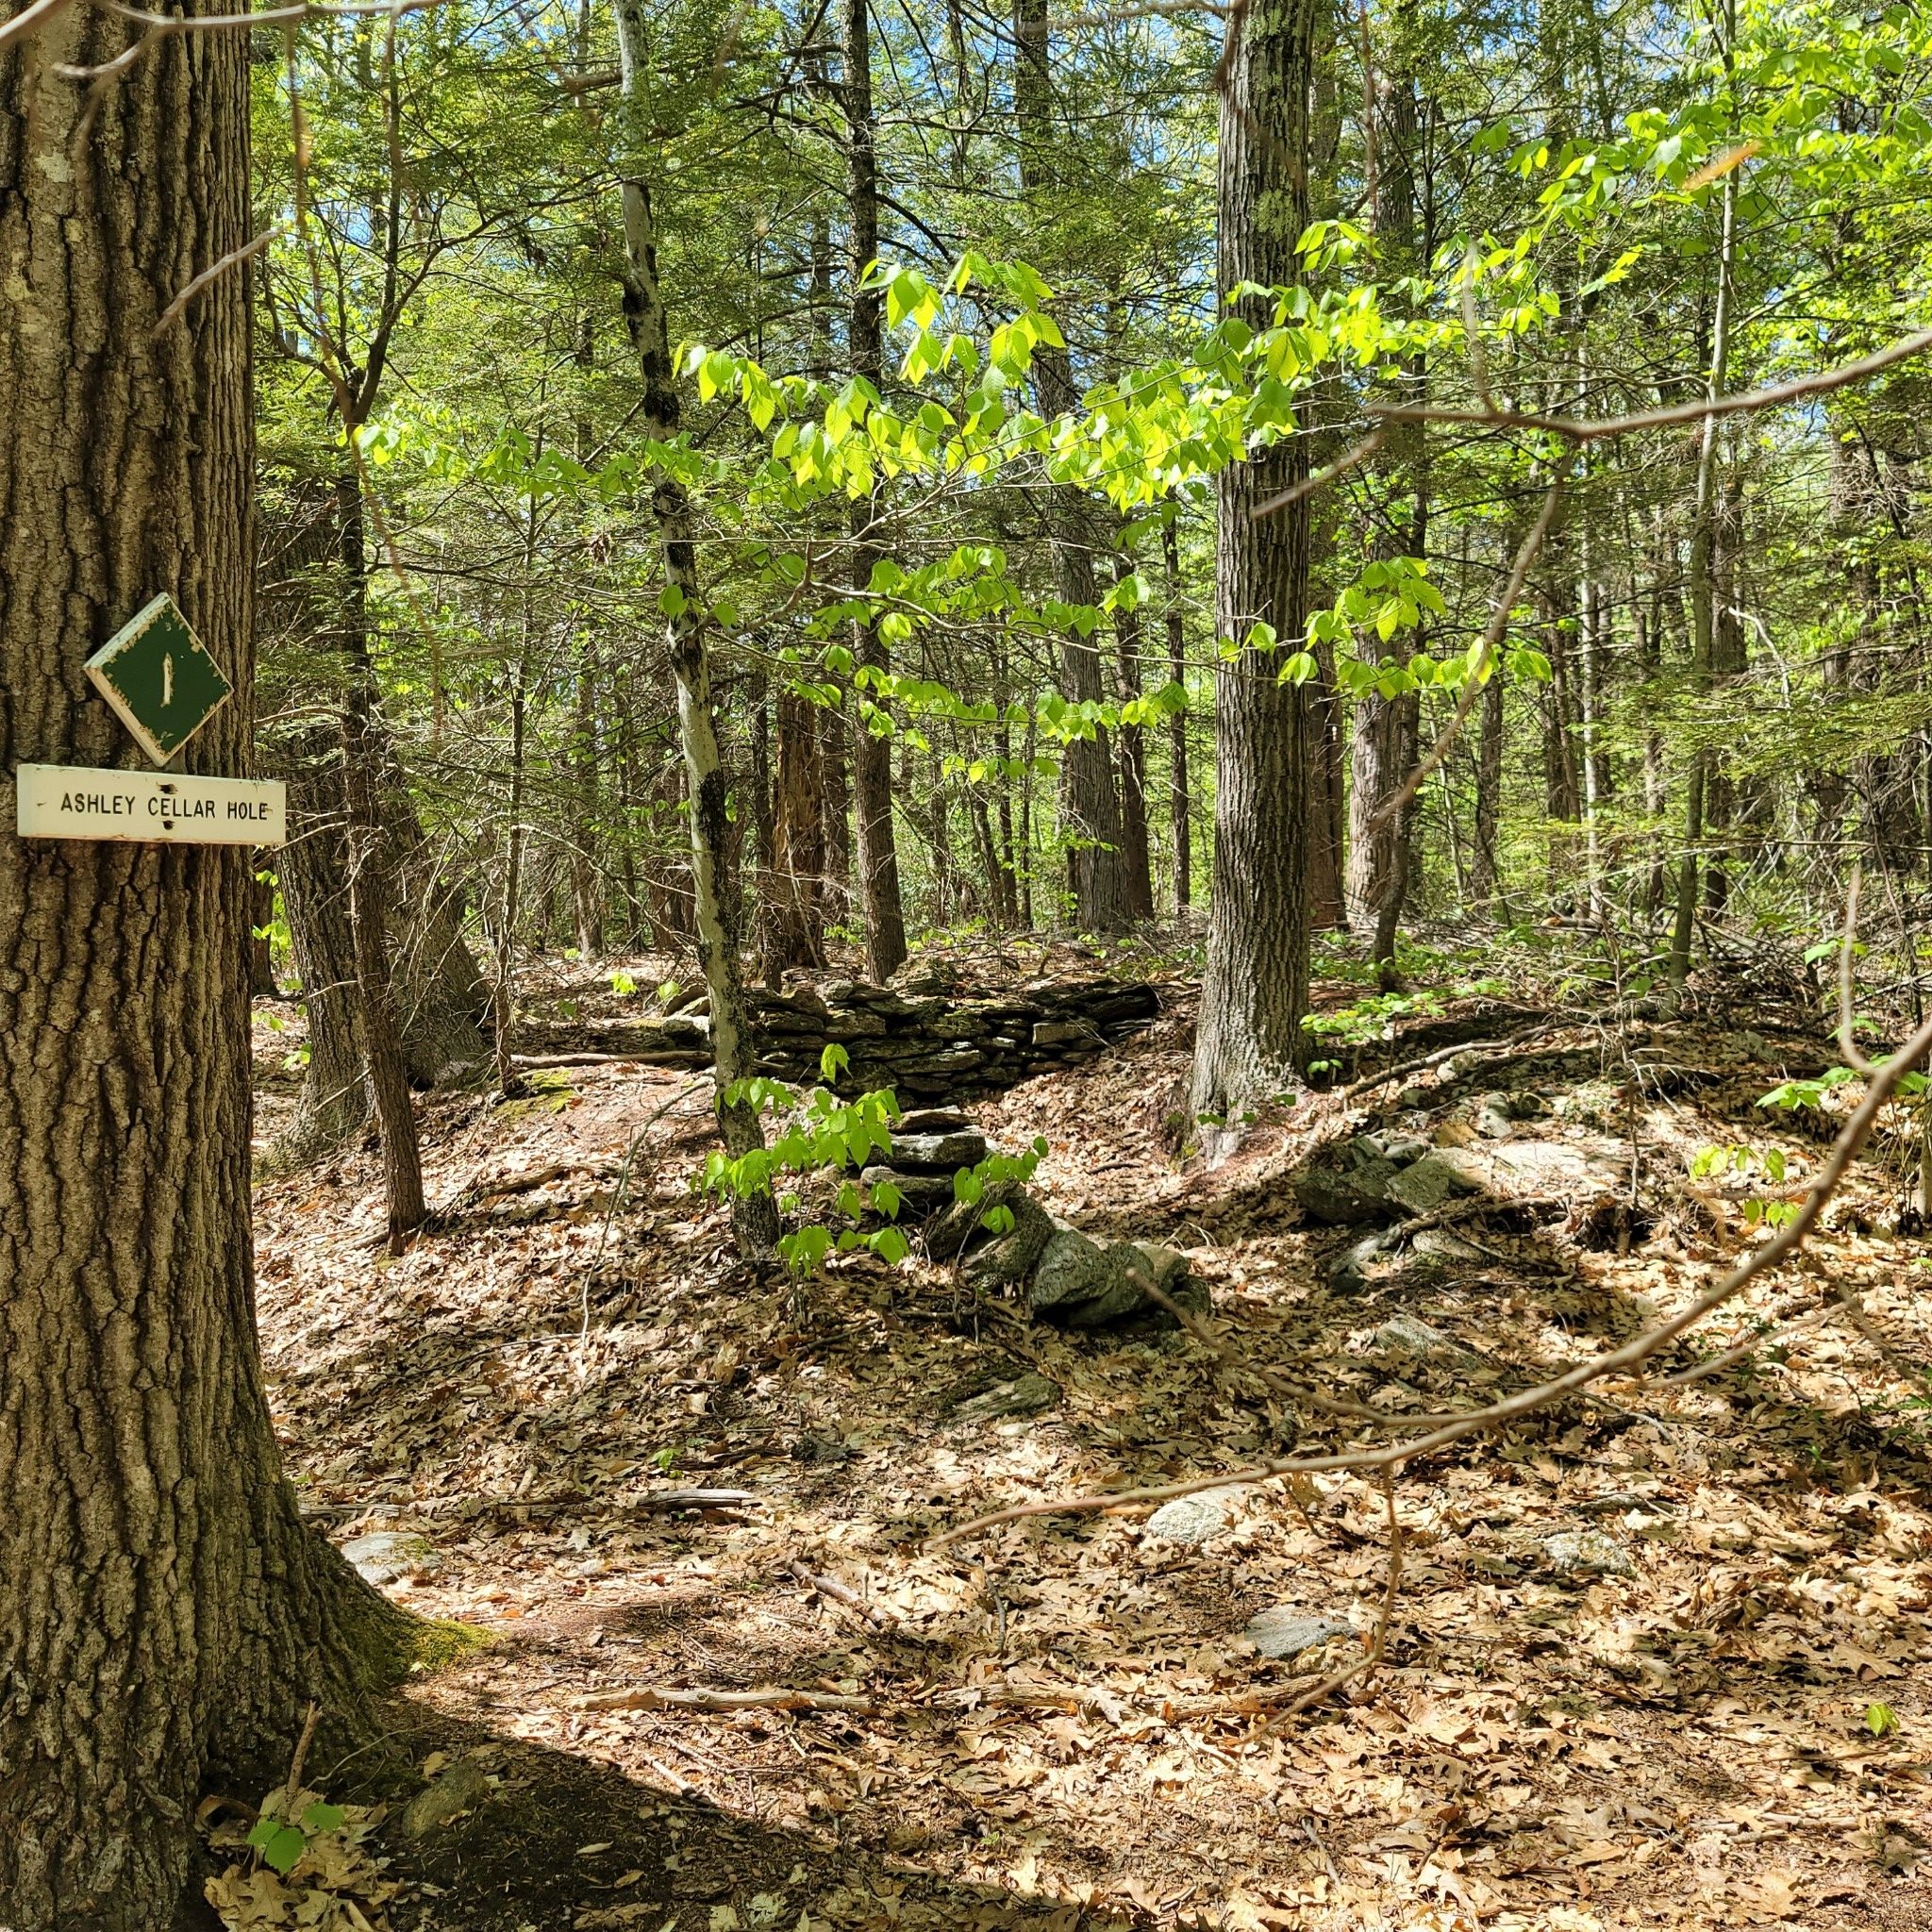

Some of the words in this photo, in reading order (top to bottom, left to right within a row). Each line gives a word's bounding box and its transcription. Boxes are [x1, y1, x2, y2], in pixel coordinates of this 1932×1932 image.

[161, 652, 175, 708] 1
[60, 792, 136, 815] ASHLEY
[147, 796, 216, 818] CELLAR
[227, 801, 268, 820] HOLE
